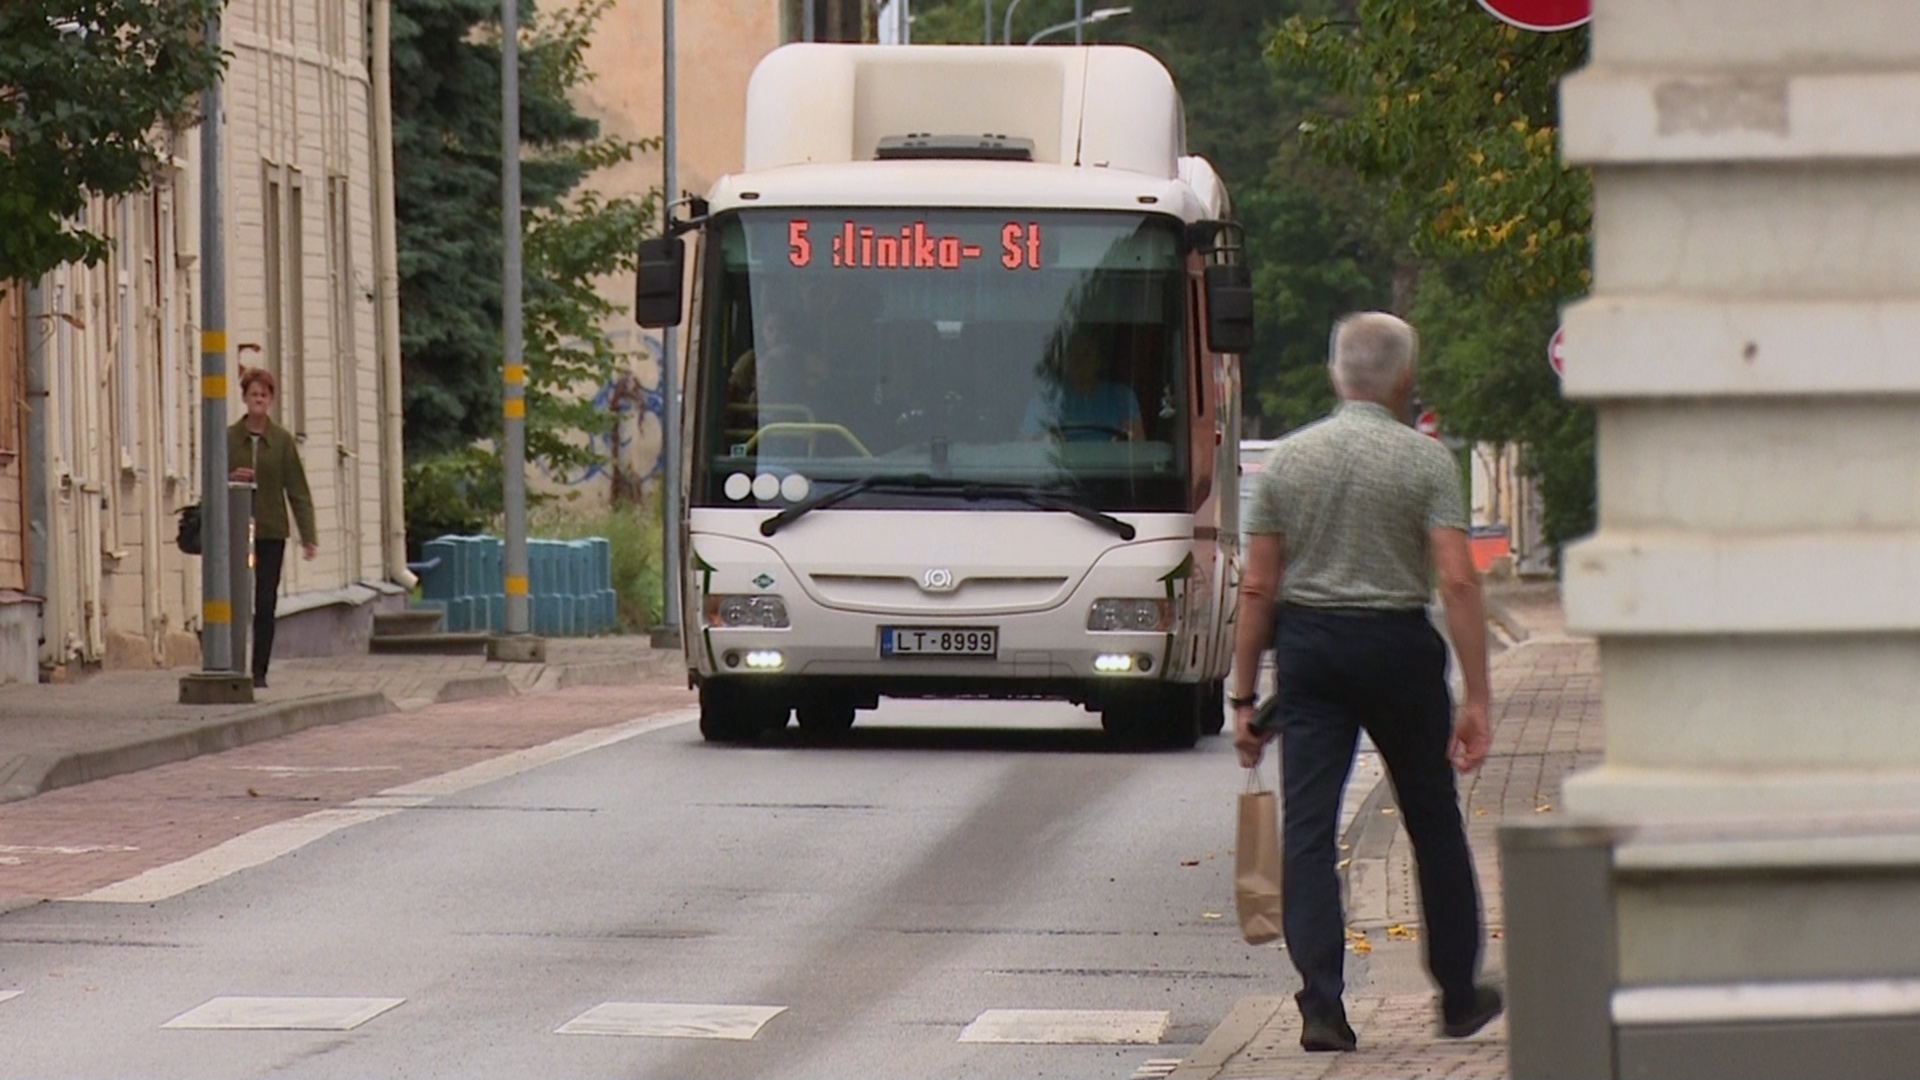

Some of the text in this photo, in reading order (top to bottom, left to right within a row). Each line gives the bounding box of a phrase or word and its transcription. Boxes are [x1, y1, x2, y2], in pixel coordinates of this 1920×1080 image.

[788, 220, 811, 267] 5
[1001, 221, 1041, 269] St
[897, 632, 992, 652] LT-8999
